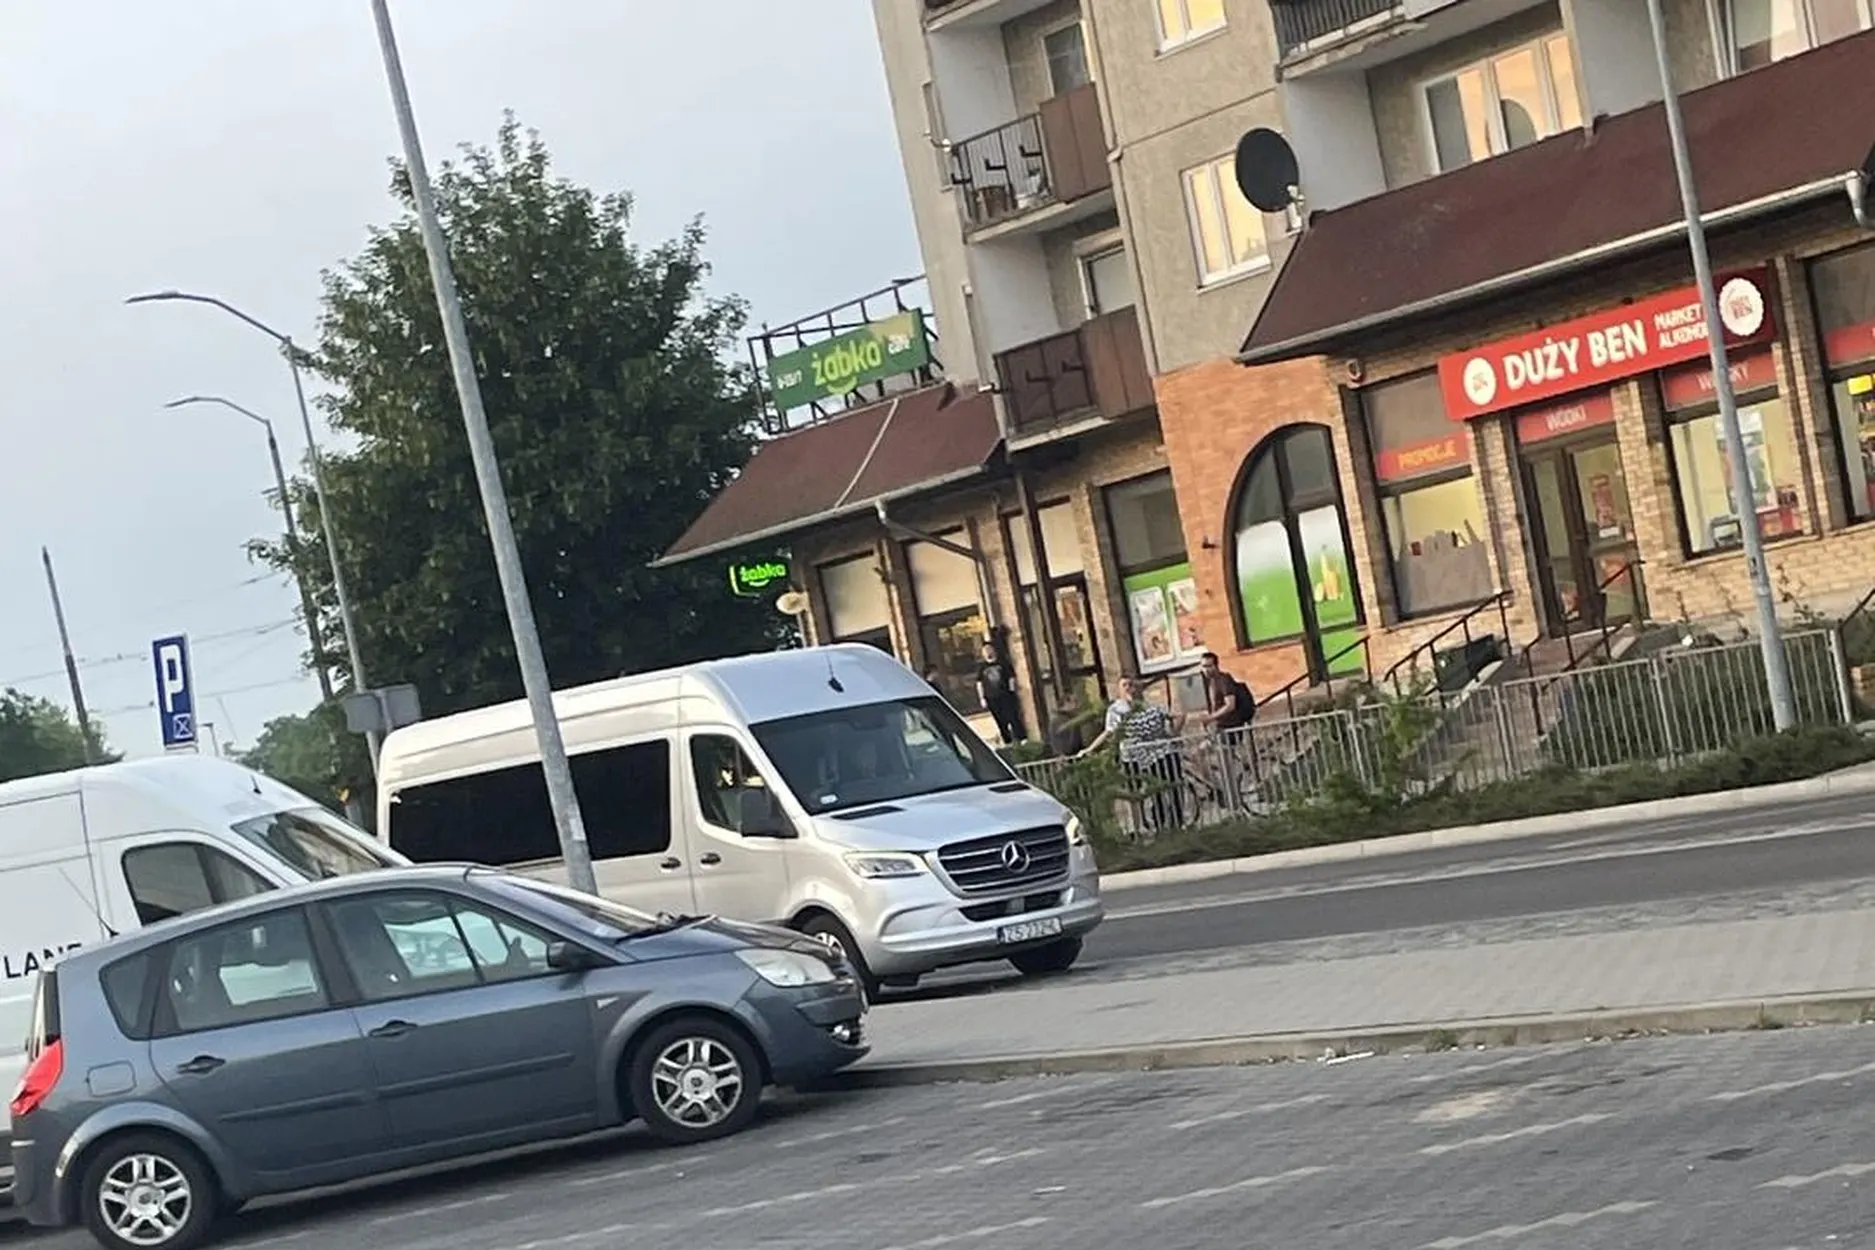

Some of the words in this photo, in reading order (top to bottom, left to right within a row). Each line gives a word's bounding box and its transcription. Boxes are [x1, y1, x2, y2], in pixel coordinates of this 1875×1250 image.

[1654, 302, 1703, 332] MARKET
[1659, 321, 1709, 349] ALKOHO
[811, 337, 883, 388] żabka
[1503, 336, 1580, 391] DUŻY
[1587, 319, 1648, 369] BEN
[160, 644, 184, 713] P
